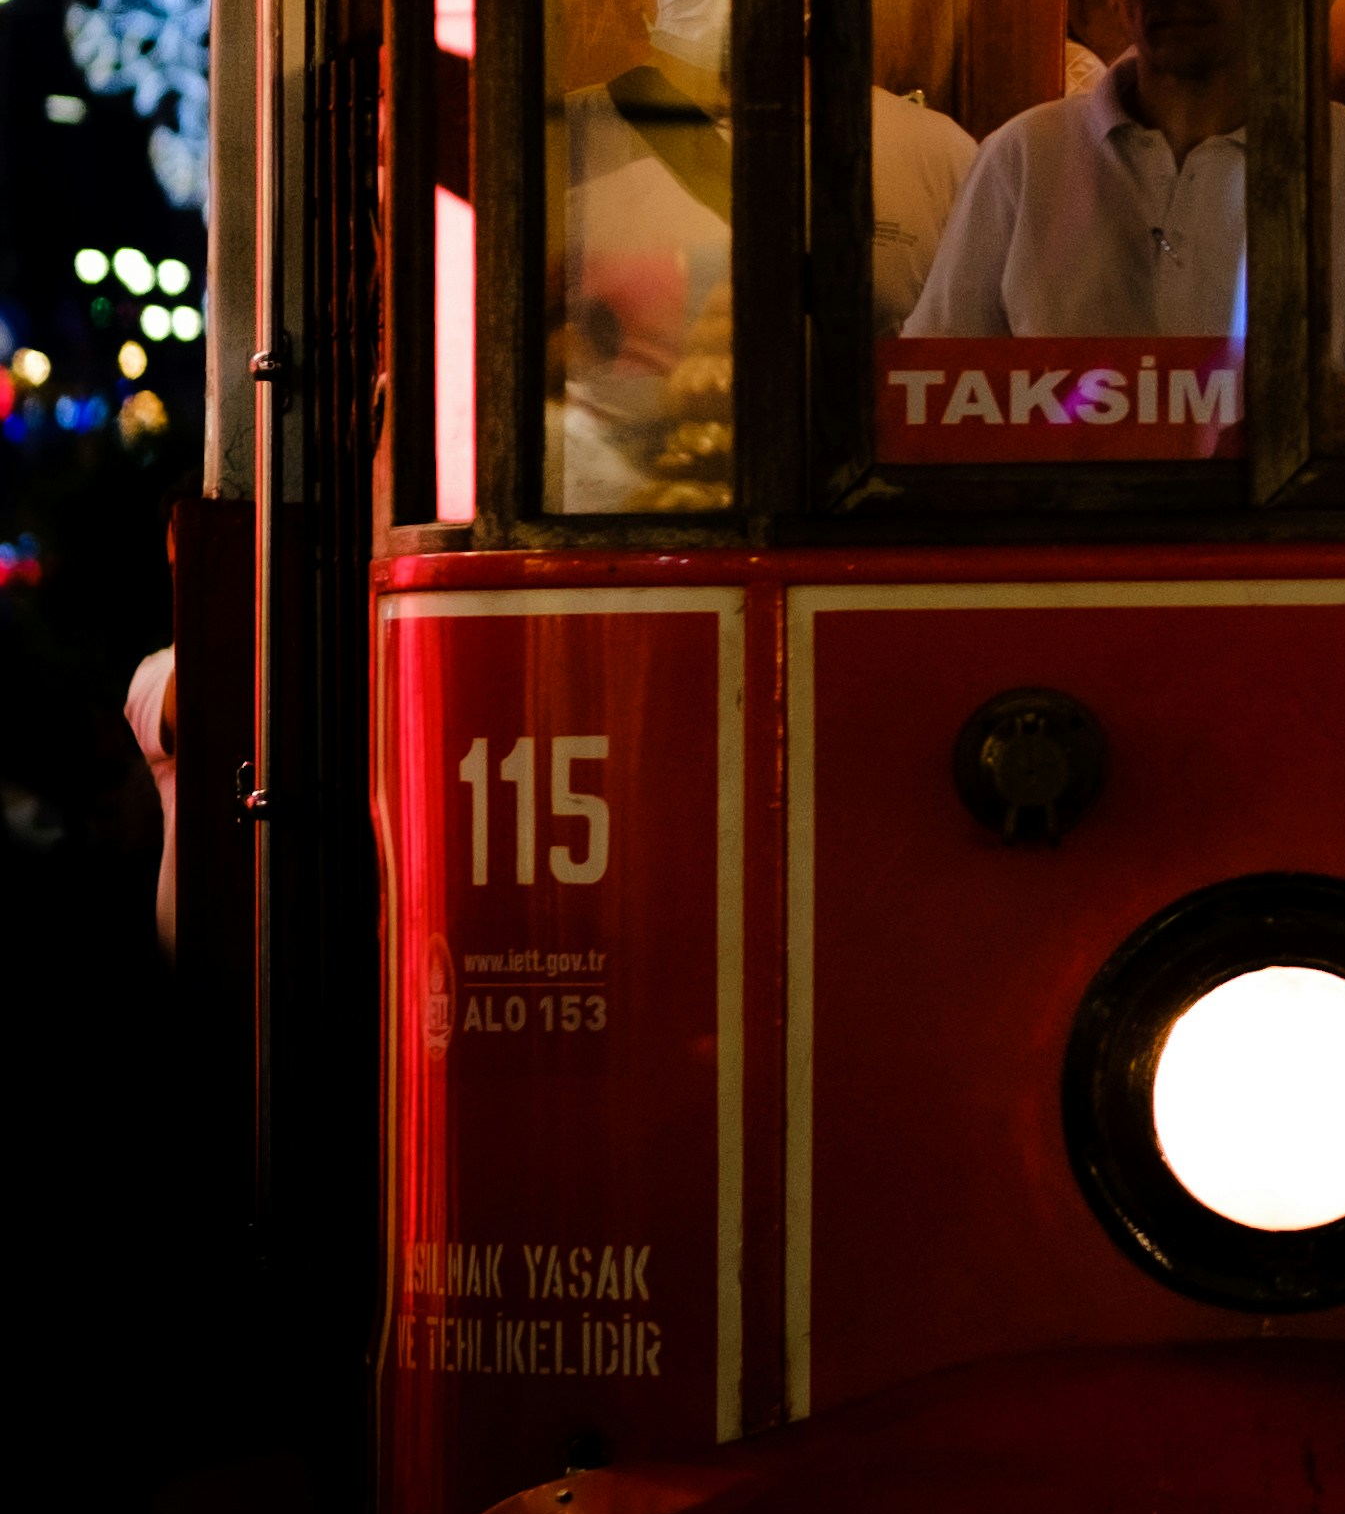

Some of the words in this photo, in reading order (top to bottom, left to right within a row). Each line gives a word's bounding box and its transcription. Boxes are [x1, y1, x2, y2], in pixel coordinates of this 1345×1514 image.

[887, 355, 1245, 426] TAKSİM
[459, 735, 610, 887] 115
[463, 995, 527, 1032] ALO
[539, 995, 607, 1032] 153
[523, 1244, 651, 1301] YASAK
[426, 1311, 662, 1377] TEHLİKELİDİR
